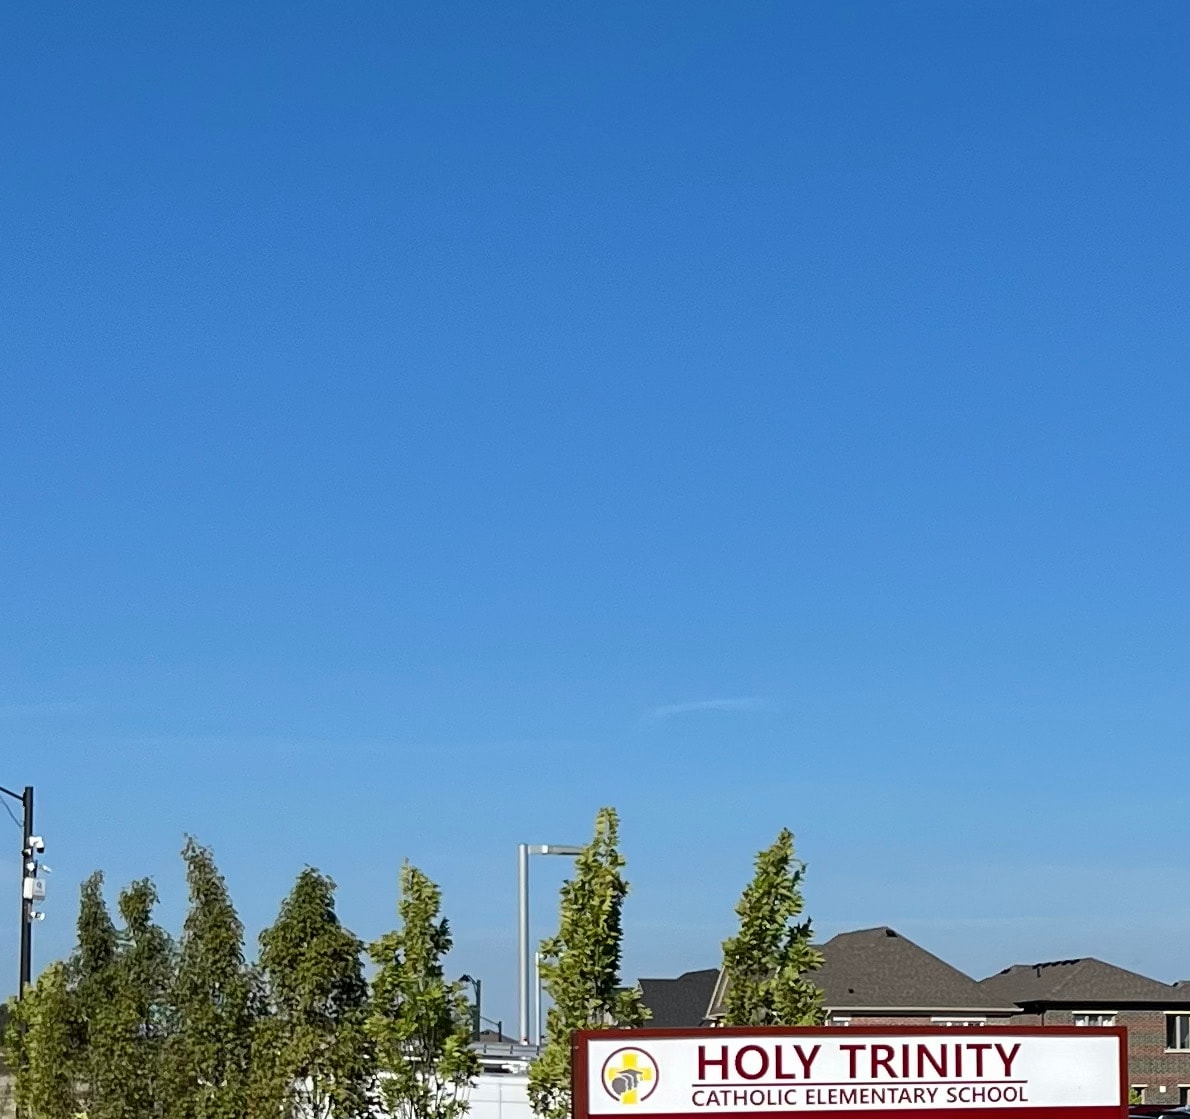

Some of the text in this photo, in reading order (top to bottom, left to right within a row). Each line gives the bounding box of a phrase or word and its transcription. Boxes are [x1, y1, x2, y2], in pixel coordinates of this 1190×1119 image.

[697, 1042, 1022, 1081] HOLY TRINITY
[691, 1086, 1029, 1107] CATHOLIC ELEMENTARY SCHOOL
